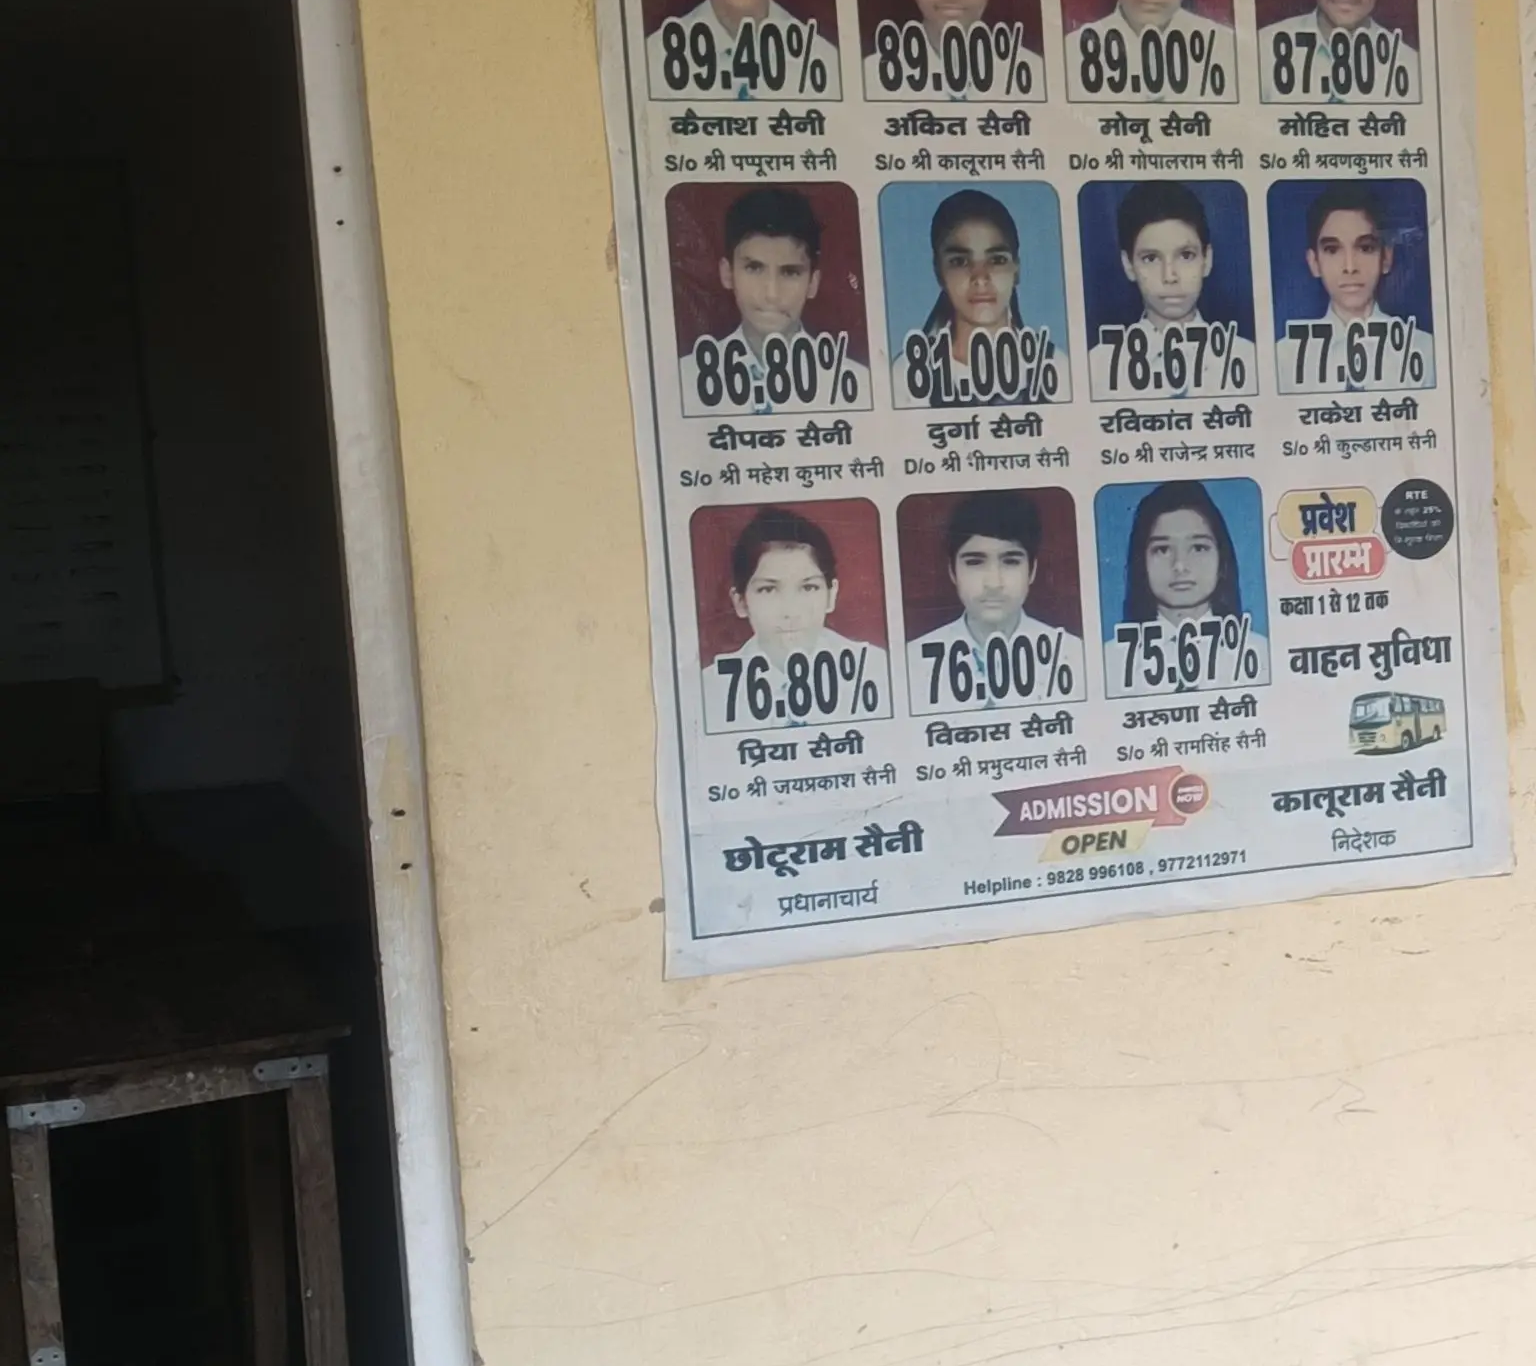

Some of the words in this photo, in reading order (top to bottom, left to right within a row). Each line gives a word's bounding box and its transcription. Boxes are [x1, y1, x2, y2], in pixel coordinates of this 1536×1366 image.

[662, 21, 827, 94] 89.40%
[877, 21, 1032, 95] 89.00%
[1080, 28, 1226, 97] 89.00%
[1272, 30, 1409, 99] 87.80%
[670, 108, 757, 137] कैलाश
[768, 108, 825, 137] सैनी
[884, 109, 967, 137] अंकित
[977, 108, 1030, 137] सैनी
[1099, 112, 1152, 143] मोनू
[1160, 111, 1211, 137] सैनी
[1278, 112, 1350, 138] मोहित
[1358, 111, 1407, 138] सैनी
[665, 153, 697, 172] S/o
[704, 149, 725, 171] श्री
[732, 154, 794, 176] पप्पूराम
[800, 148, 837, 172] सैनी
[938, 153, 1006, 176] कालूराम
[1012, 148, 1045, 172] सैनी
[1069, 153, 1100, 171] D/o
[1105, 149, 1125, 171] श्री
[1130, 149, 1207, 171] गोपालराम
[1213, 148, 1244, 171] सैनी
[1398, 148, 1428, 170] सैनी
[905, 331, 1058, 401] 81.00%
[1101, 322, 1245, 391] 78.67%
[1288, 319, 1423, 385] 77.67%
[695, 336, 858, 407] 86.80%
[1099, 408, 1193, 435] रविकांत
[1202, 404, 1252, 429] सैनी
[1298, 400, 1362, 426] राकेश
[1371, 396, 1419, 423] सैनी
[707, 423, 786, 451] दीपक
[796, 419, 852, 447] सैनी
[927, 415, 979, 449] दुर्गा
[989, 412, 1043, 439] सैनी
[1407, 430, 1437, 450] सैनी
[1036, 446, 1069, 468] सैनी
[1159, 441, 1206, 463] राजेन्द्र
[1214, 443, 1256, 462] प्रसाद
[680, 470, 712, 488] S/o
[720, 464, 741, 486] श्री
[747, 460, 789, 485] महेश
[796, 464, 842, 488] कुमार
[849, 456, 885, 480] सैनी
[1298, 492, 1357, 536] प्रवेश
[1302, 542, 1373, 578] प्रारम्भ
[1346, 592, 1360, 613] 12
[1365, 590, 1390, 610] तक
[921, 632, 1074, 705] 76.00%
[1117, 617, 1259, 688] 75.67%
[1288, 644, 1361, 678] वाहन
[1368, 627, 1452, 681] सुविधा
[717, 647, 879, 723] 76.80%
[1208, 695, 1258, 720] सैनी
[926, 719, 1011, 747] विकास
[1020, 713, 1075, 739] सैनी
[1174, 734, 1231, 756] रामसिंह
[1236, 729, 1267, 751] सैनी
[737, 738, 798, 768] प्रिया
[808, 731, 865, 758] सैनी
[977, 752, 1048, 780] प्रभुदयाल
[1054, 745, 1088, 768] सैनी
[708, 784, 740, 802] S/o
[747, 775, 767, 798] श्री
[772, 771, 856, 795] जयप्रकाश
[862, 763, 897, 787] सैनी
[1272, 784, 1385, 819] कालूराम
[1392, 769, 1447, 803] सैनी
[1020, 785, 1158, 822] ADMISSION
[723, 836, 846, 877] छोटूराम
[855, 819, 924, 857] सैनी
[1061, 830, 1127, 856] OPEN
[1331, 828, 1397, 852] निदेशक
[1046, 867, 1085, 886] 9828
[1089, 861, 1145, 882] 996108
[1157, 850, 1247, 873] 9772112971
[778, 879, 879, 917] प्रधानाचार्य
